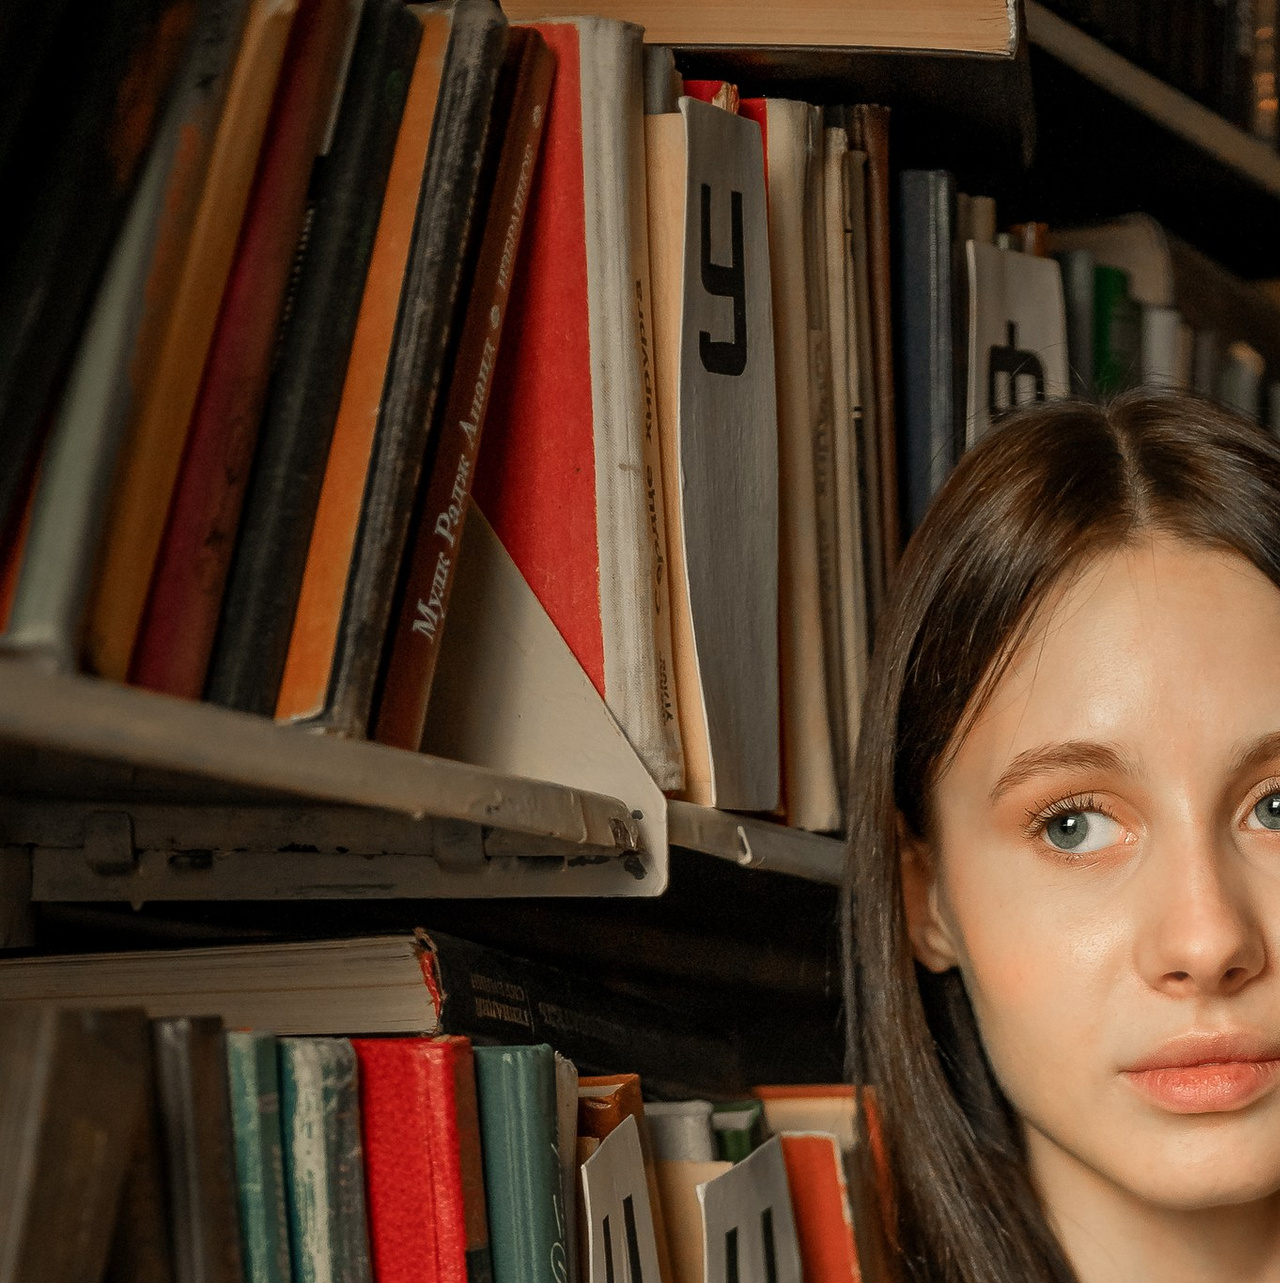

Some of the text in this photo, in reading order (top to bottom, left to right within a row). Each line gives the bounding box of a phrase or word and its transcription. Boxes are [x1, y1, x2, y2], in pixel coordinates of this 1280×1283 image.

[413, 552, 450, 642] Мулк
[435, 454, 470, 547] Радж
[459, 338, 496, 450] Ананд
